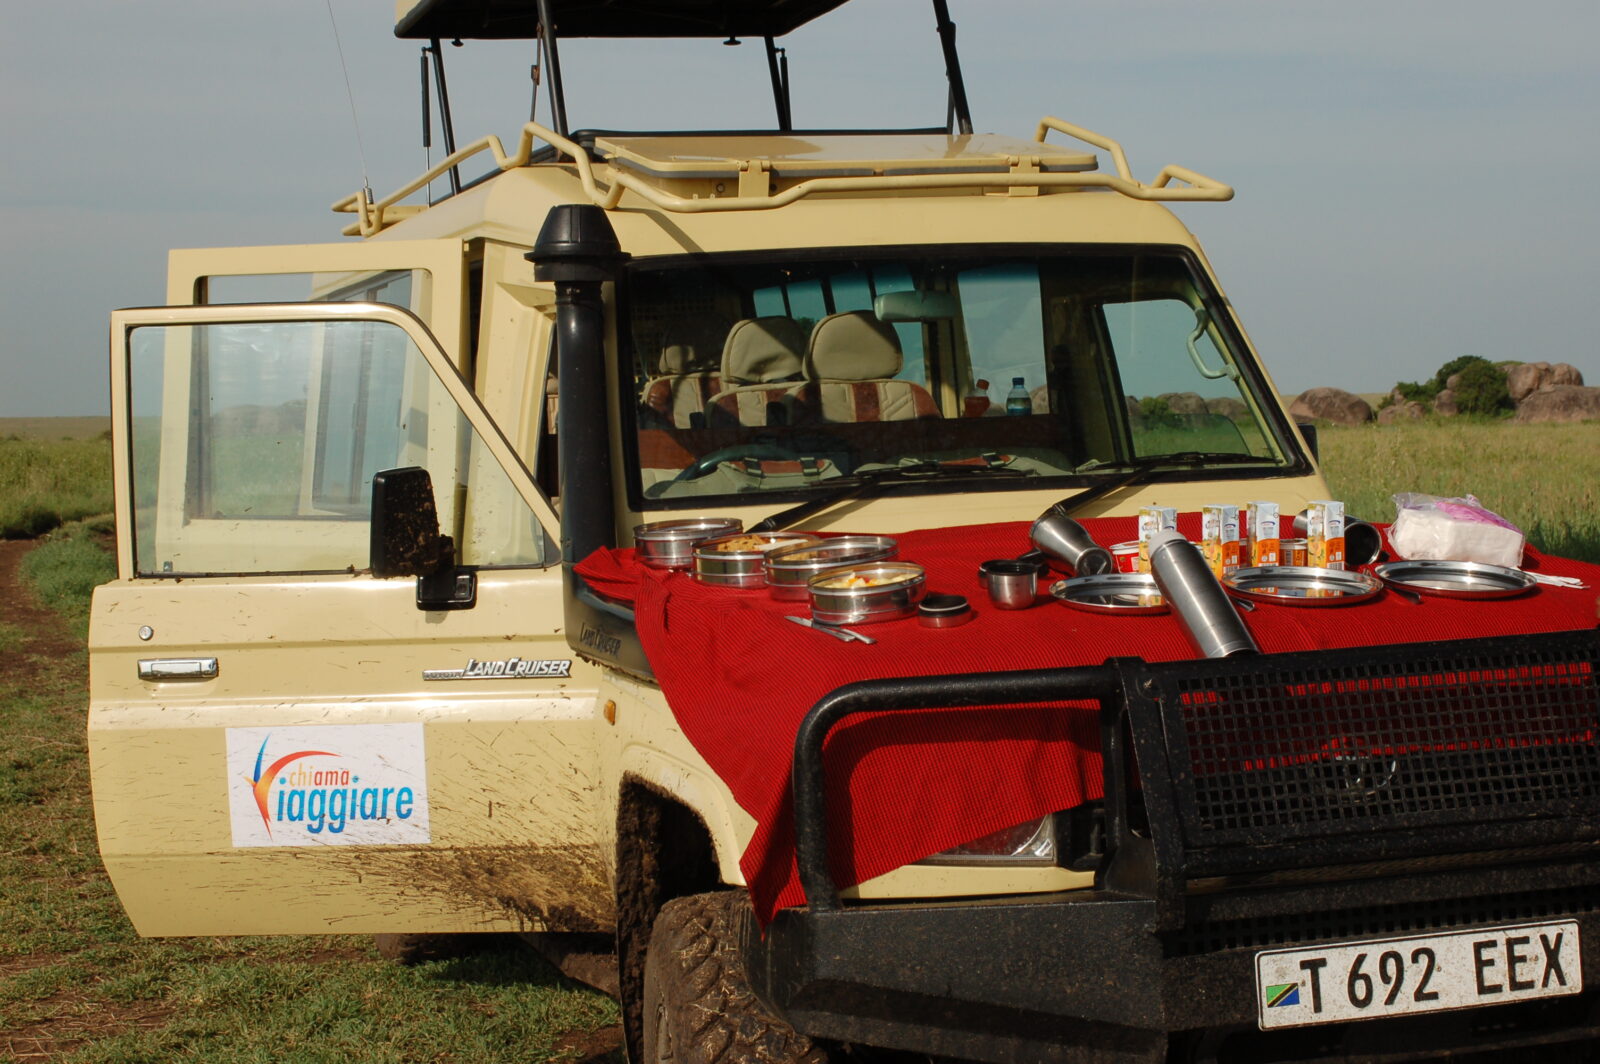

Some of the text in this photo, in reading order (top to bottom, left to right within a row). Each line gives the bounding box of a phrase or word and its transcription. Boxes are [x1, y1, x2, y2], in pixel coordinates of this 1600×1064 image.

[1299, 932, 1568, 1014] T 692 EEX
